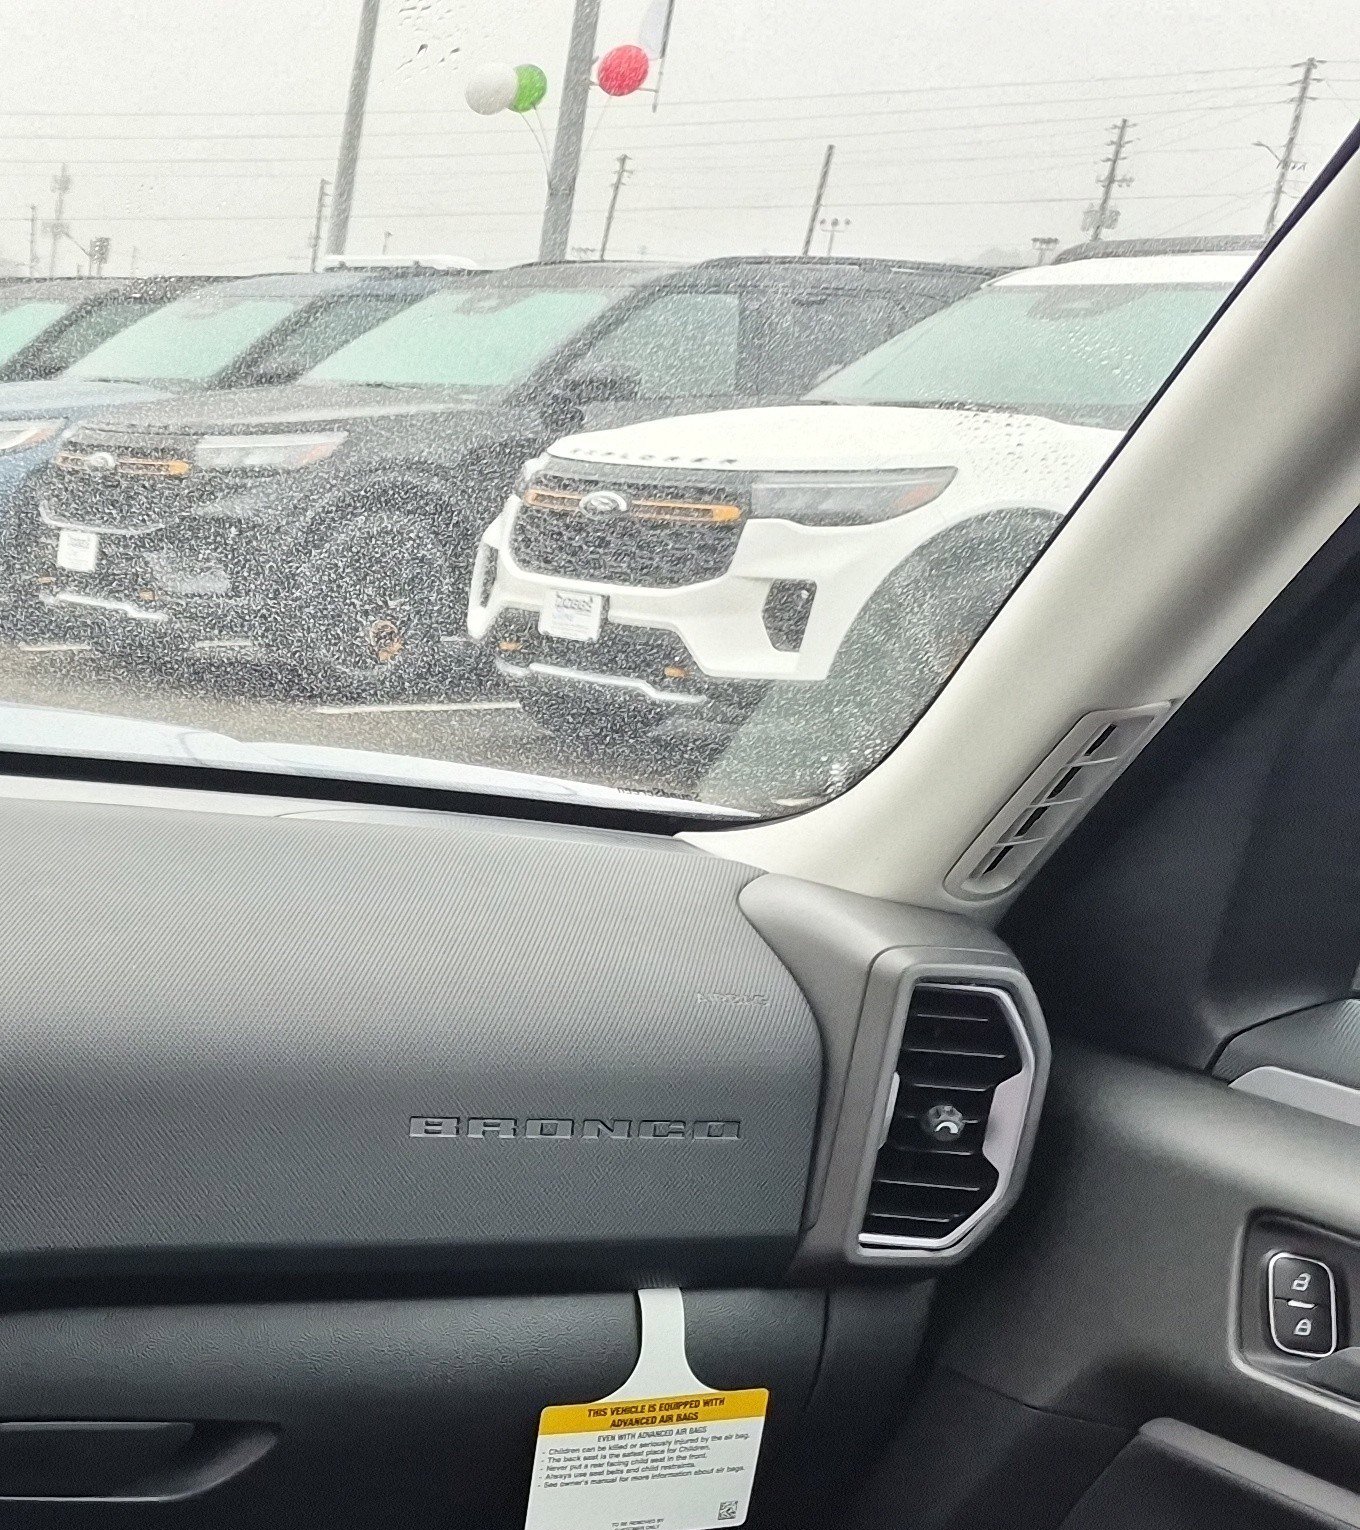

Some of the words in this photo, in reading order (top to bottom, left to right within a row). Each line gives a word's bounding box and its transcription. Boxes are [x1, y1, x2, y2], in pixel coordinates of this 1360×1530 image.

[409, 1116, 741, 1141] BRONCO
[588, 1408, 608, 1418] THIS
[610, 1405, 646, 1416] VEHICLE
[648, 1403, 656, 1413] IS
[659, 1400, 700, 1412] EQUIPPED
[703, 1397, 725, 1408] WITH
[610, 1416, 657, 1428] ADVANCED
[658, 1414, 674, 1424] AIR
[676, 1412, 699, 1422] BAGS
[597, 1434, 616, 1442] EVEN
[637, 1429, 674, 1438] ADVANCED
[675, 1427, 687, 1436] AIR
[689, 1426, 708, 1435] BAGS
[606, 1460, 629, 1468] facing
